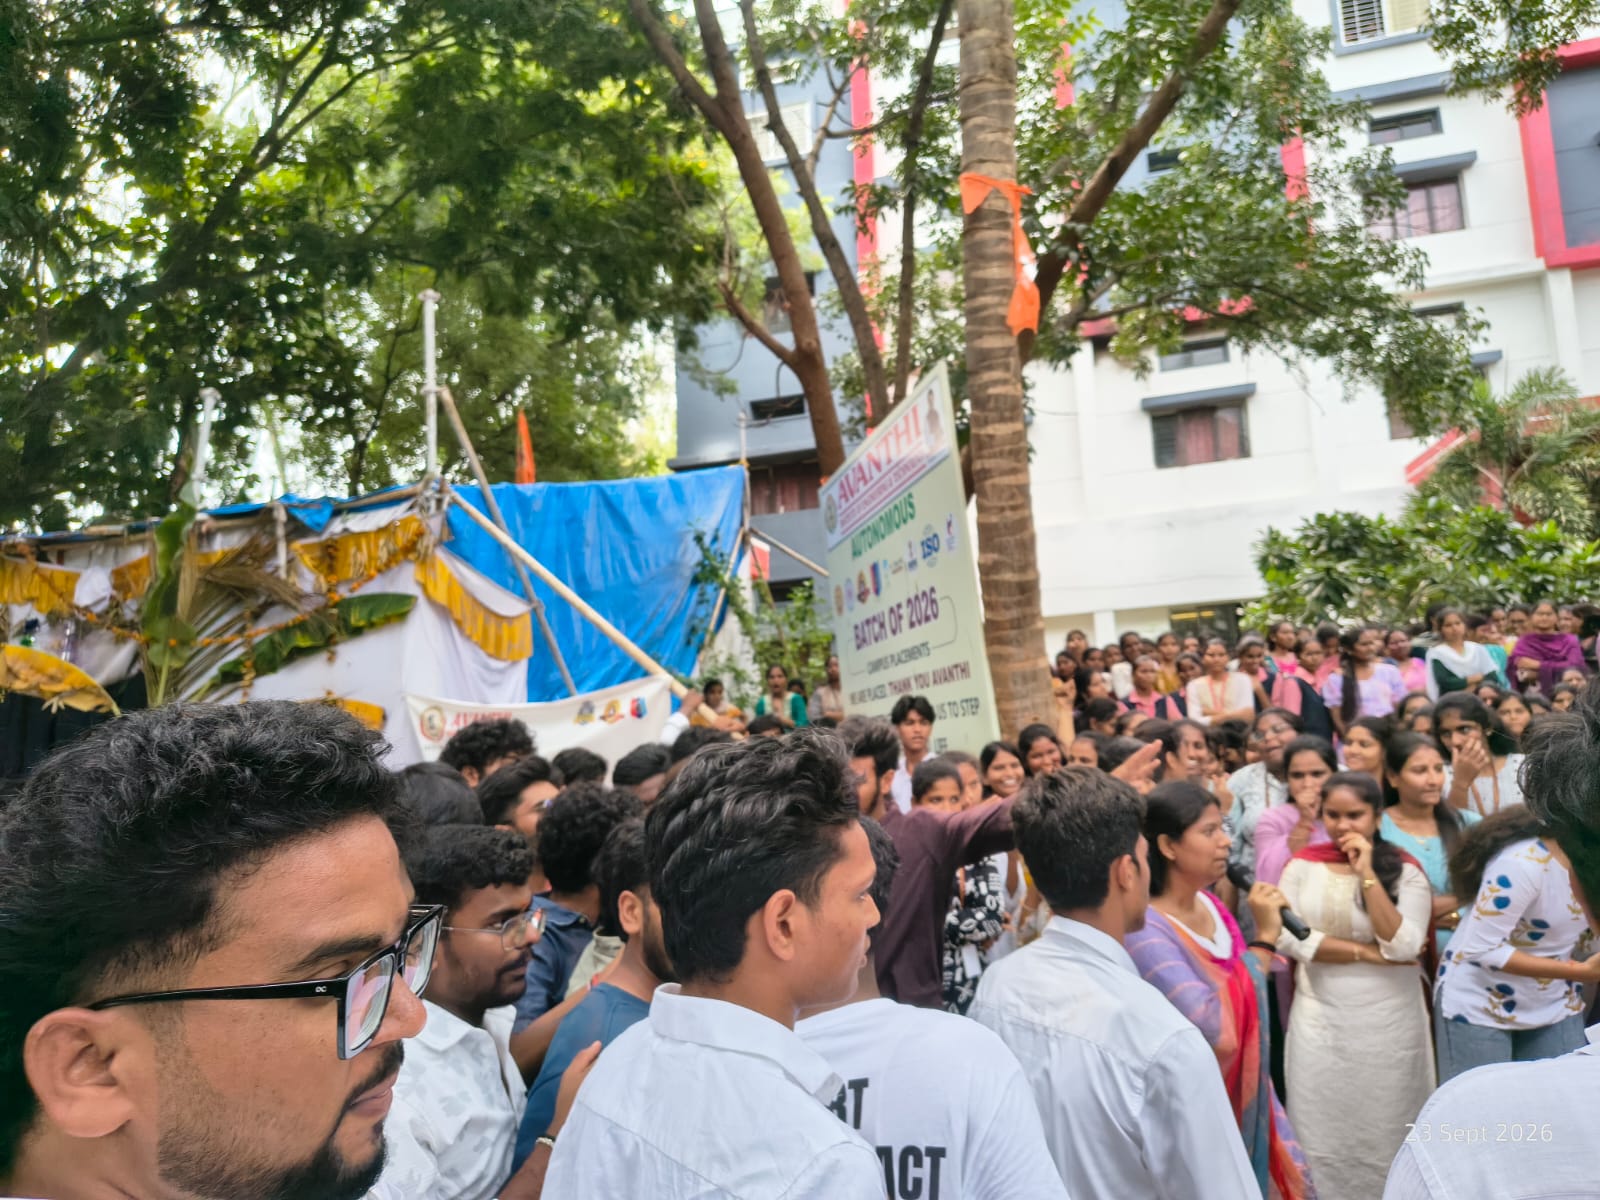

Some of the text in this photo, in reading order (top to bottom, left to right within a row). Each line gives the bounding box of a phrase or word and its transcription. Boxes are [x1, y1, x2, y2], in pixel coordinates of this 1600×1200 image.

[837, 405, 922, 511] AVANTHI
[851, 492, 916, 559] AUTONOMOUS
[921, 533, 940, 559] ISO
[853, 586, 940, 651] BATCH OF 2026
[888, 677, 913, 695] THANK
[913, 672, 931, 689] YOU
[932, 660, 971, 686] AVANTHI
[947, 700, 959, 718] TO
[960, 697, 980, 717] STEP
